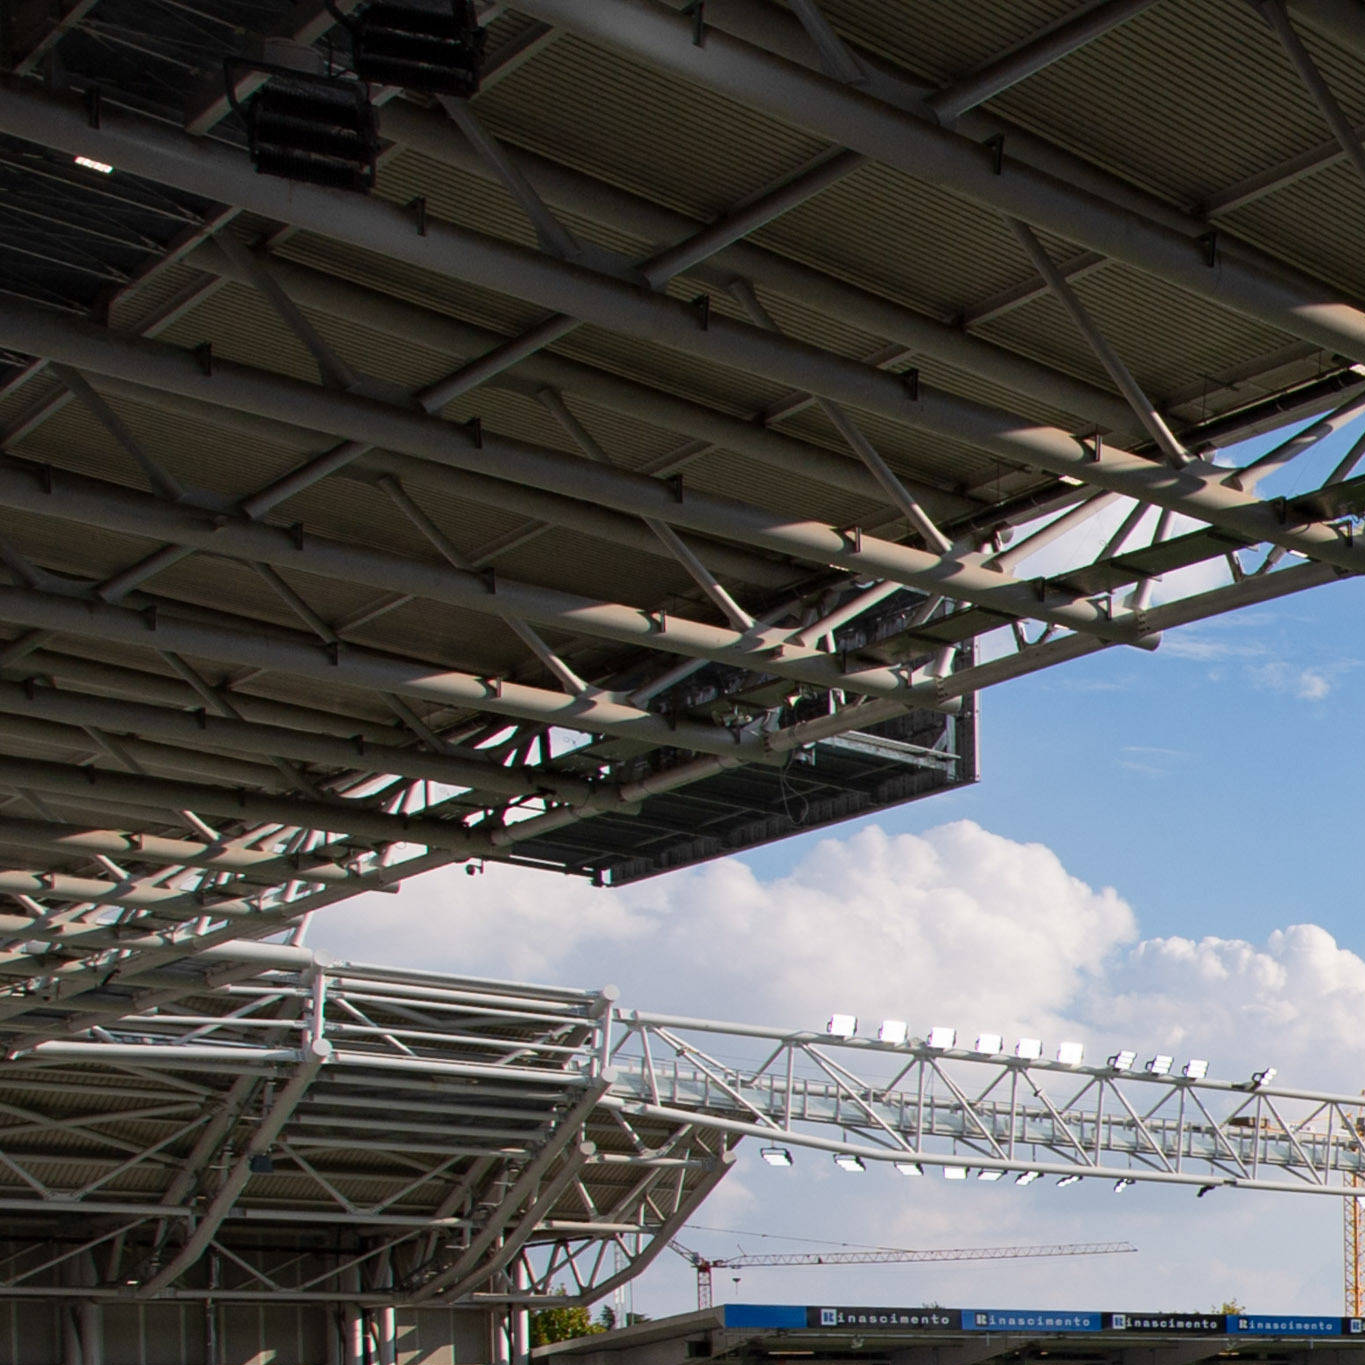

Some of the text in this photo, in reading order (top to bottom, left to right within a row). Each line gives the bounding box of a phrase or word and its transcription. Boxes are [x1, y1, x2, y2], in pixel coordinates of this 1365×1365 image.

[821, 1309, 950, 1326] Rinascimento
[976, 1313, 1091, 1327] Rinascimento
[1113, 1314, 1218, 1329] Rinascimento
[1239, 1319, 1333, 1331] Rinascimento
